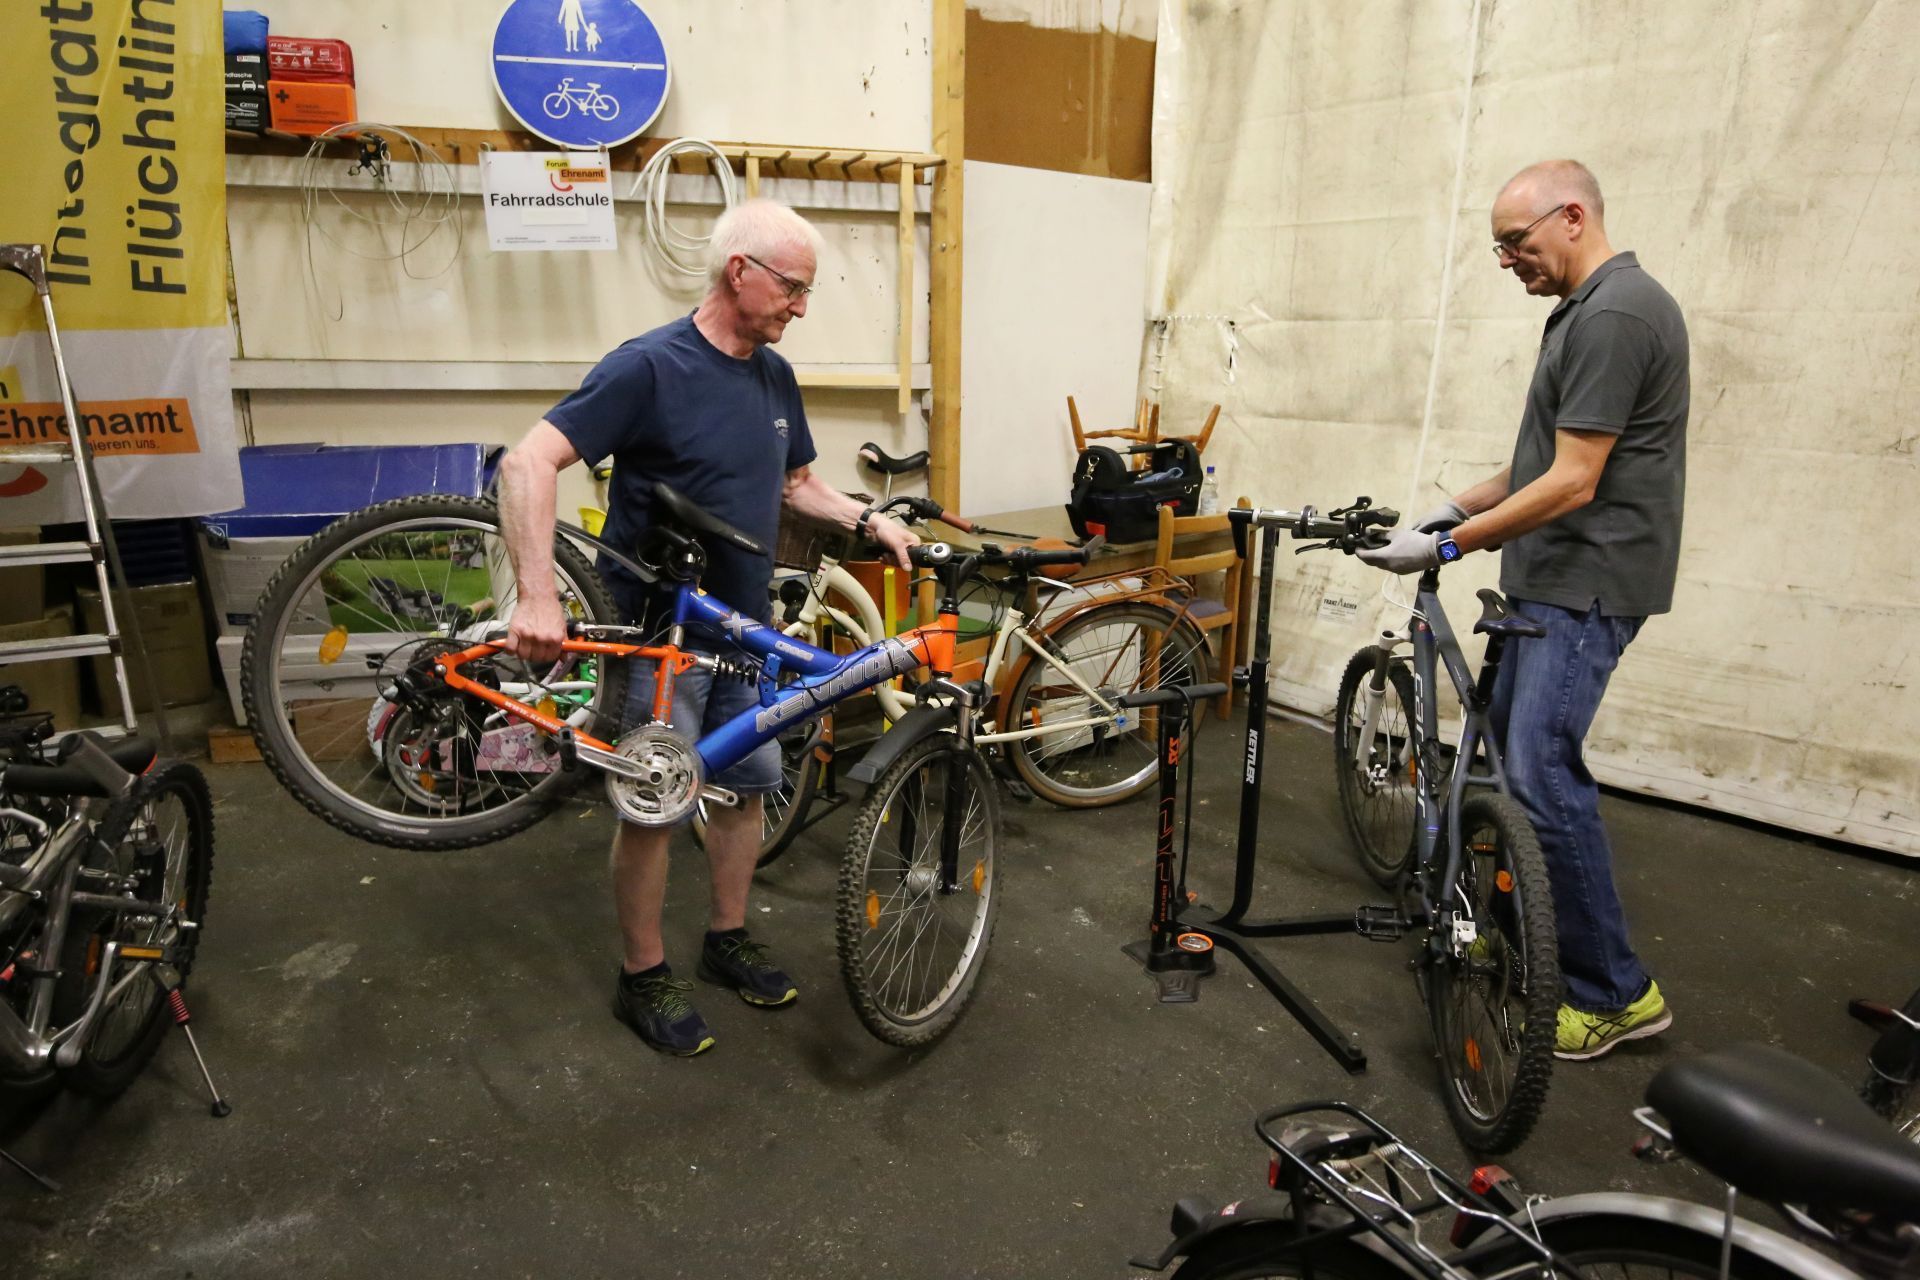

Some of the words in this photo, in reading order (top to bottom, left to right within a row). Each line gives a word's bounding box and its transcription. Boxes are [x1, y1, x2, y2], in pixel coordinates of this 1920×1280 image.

[118, 0, 187, 294] Flüchtlin
[561, 169, 605, 178] Ehrenamt
[490, 193, 609, 206] Fahrradschule
[1168, 737, 1180, 765] SKS
[1246, 728, 1258, 785] KETTLER
